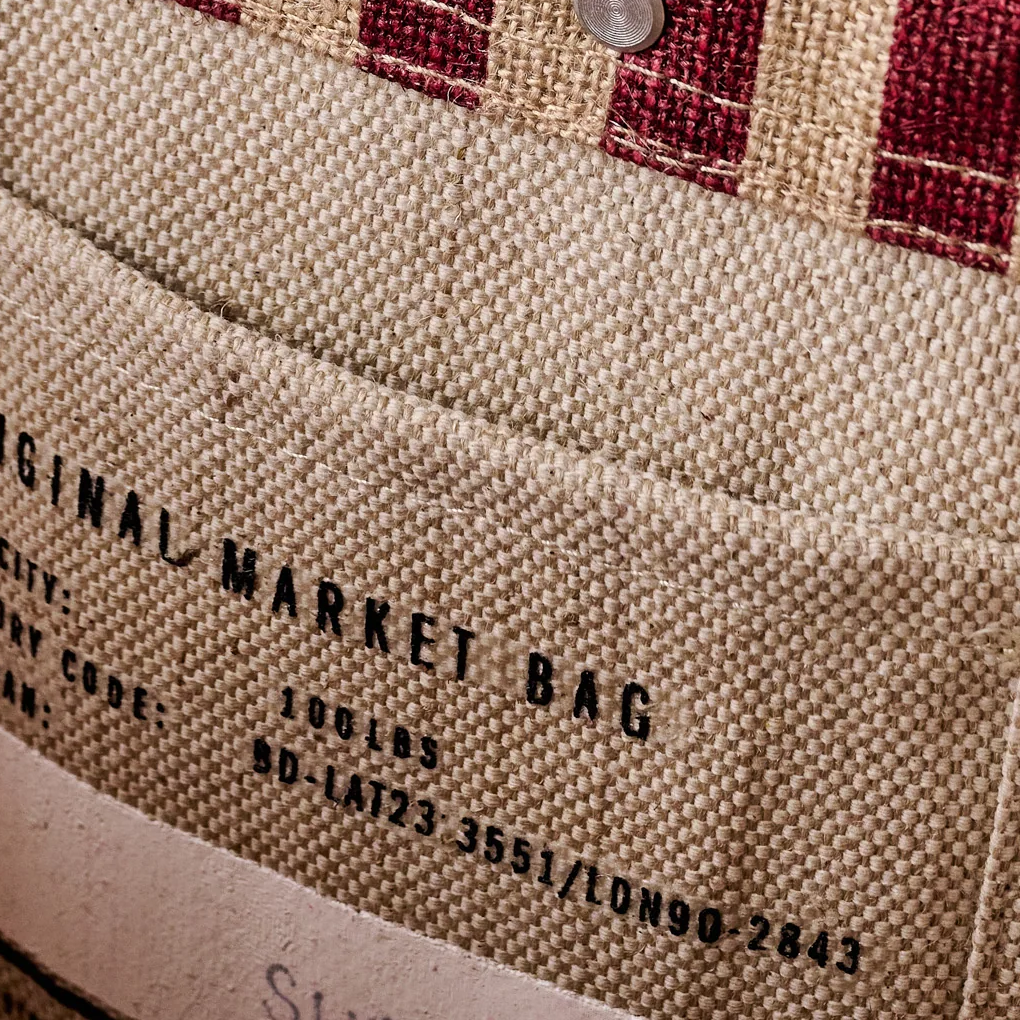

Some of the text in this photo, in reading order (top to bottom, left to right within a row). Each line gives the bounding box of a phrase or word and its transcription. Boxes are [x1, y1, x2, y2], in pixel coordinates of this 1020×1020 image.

[221, 537, 475, 681] MARKET
[525, 651, 651, 742] BAG
[61, 649, 166, 729] CODE:
[280, 686, 439, 769] 100LBS
